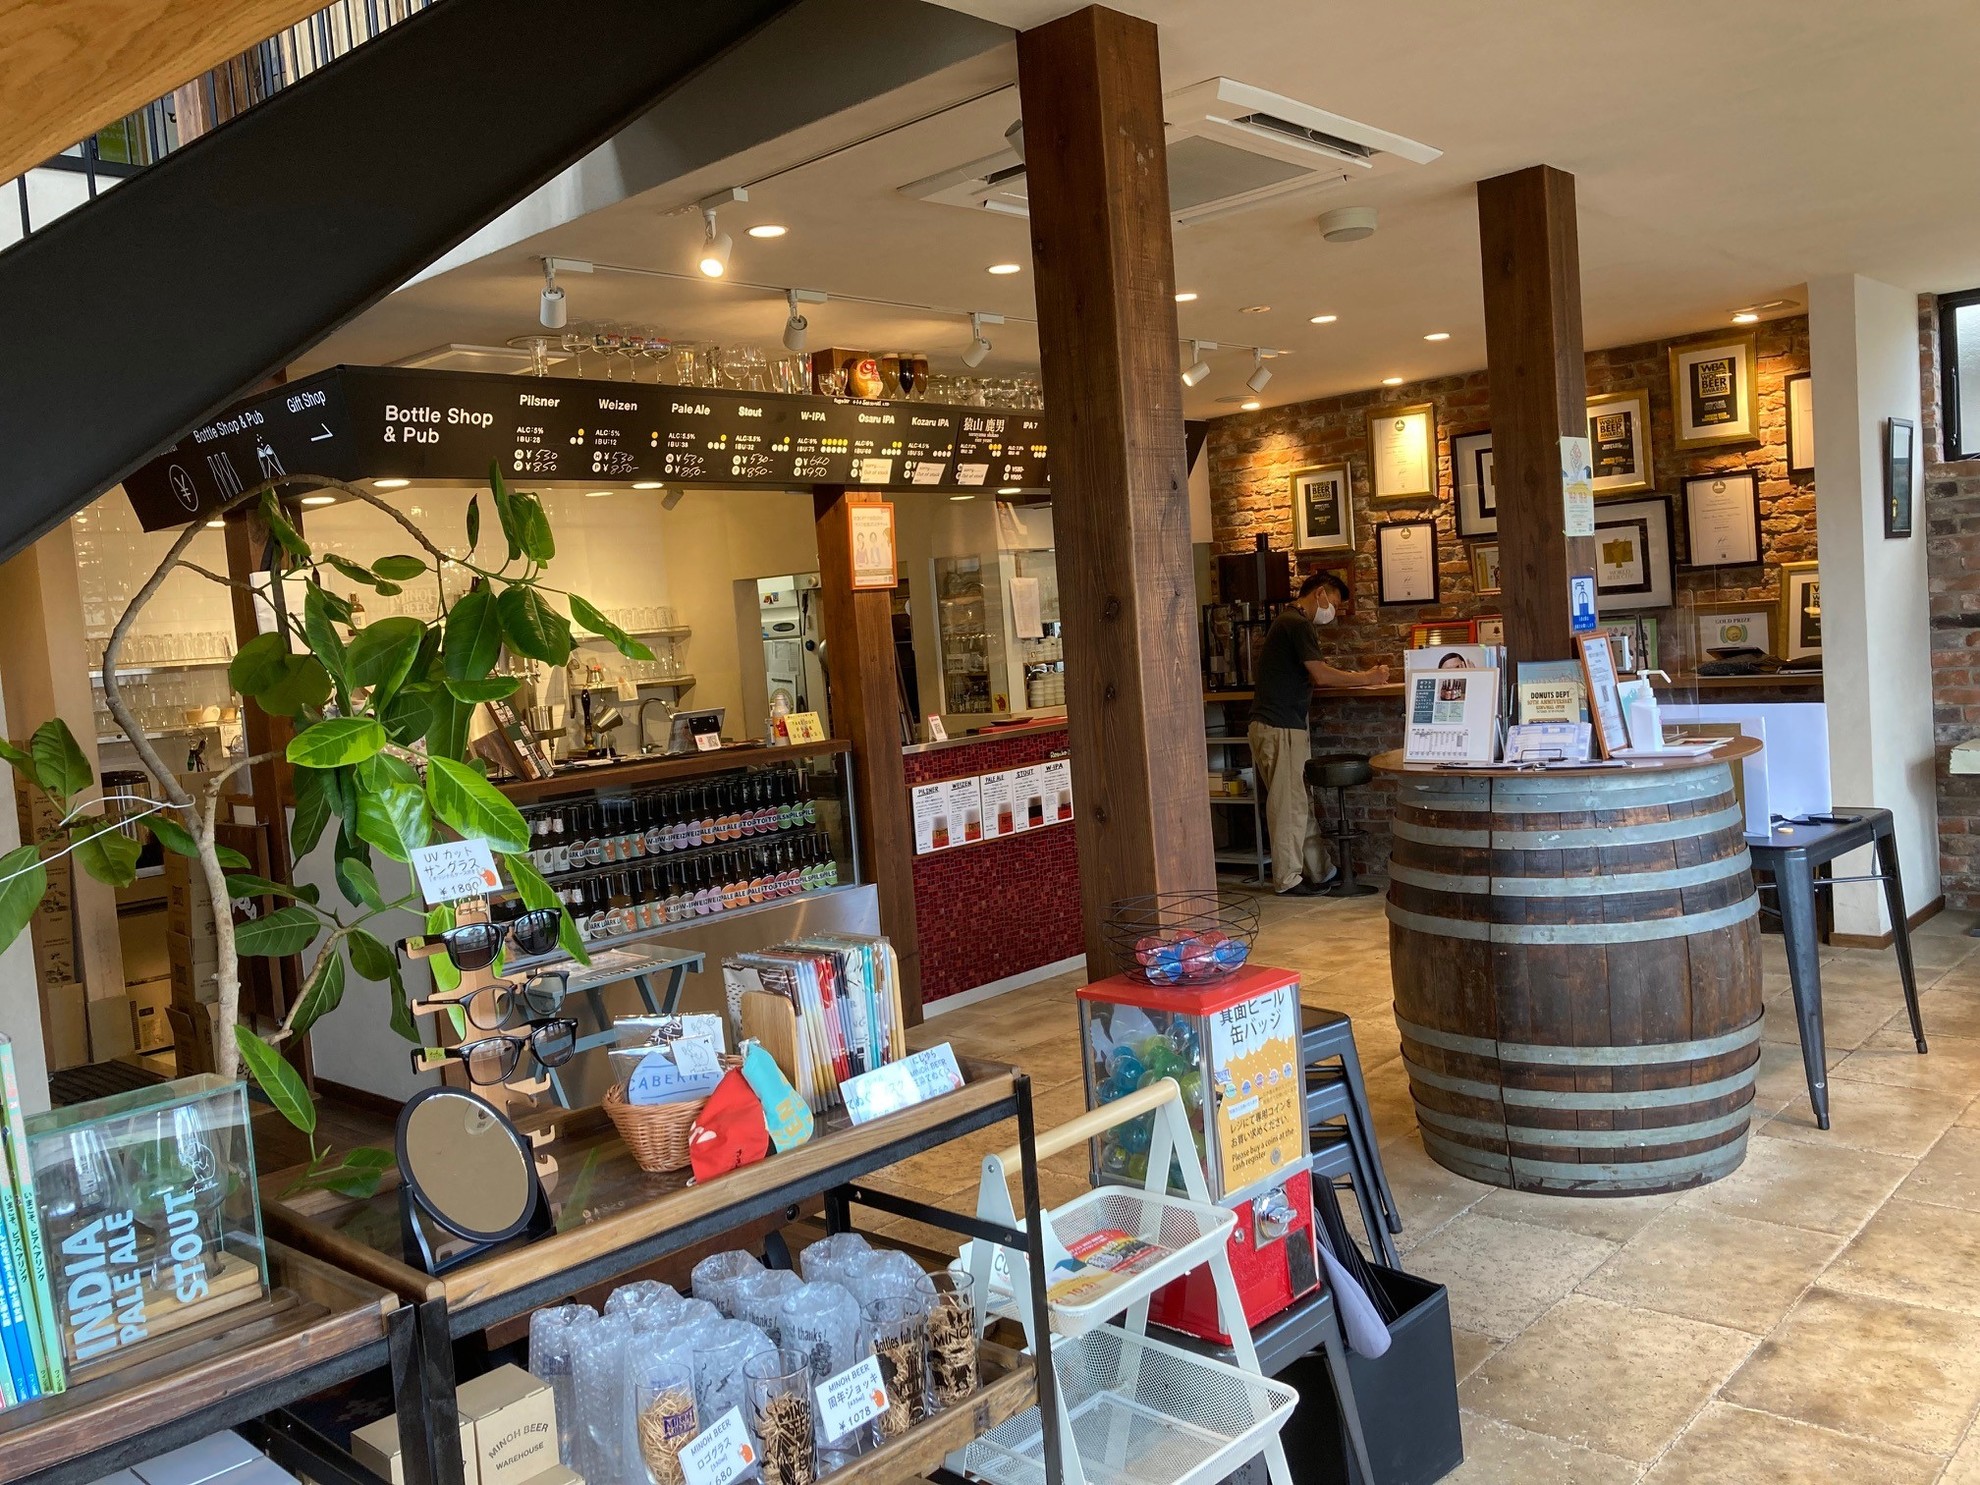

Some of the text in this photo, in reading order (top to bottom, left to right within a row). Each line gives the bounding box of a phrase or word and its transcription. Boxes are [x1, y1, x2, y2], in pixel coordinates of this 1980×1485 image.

[1700, 361, 1726, 373] WBA
[1701, 378, 1727, 388] BEER
[286, 390, 326, 414] Gift Shop
[519, 394, 561, 408] Pilsner
[598, 398, 638, 411] Weizen
[671, 403, 711, 416] Pale Ale
[385, 404, 494, 429] Bottle Shop
[738, 406, 763, 417] Stout
[858, 413, 895, 424] Osaru IPA
[193, 410, 265, 444] Bottle Shop & Pub
[516, 426, 544, 434] ALC:5%
[911, 416, 950, 427] Kozaru IPA
[1600, 424, 1622, 434] BEER
[383, 426, 440, 444] & Pub
[594, 438, 618, 446] IBU:12
[595, 429, 621, 437] ALC:5%
[1312, 486, 1331, 494] BEER
[1530, 690, 1570, 699] DONUTS DEPT
[424, 846, 472, 863] UV カット
[424, 858, 480, 877] サングラス
[1230, 1009, 1281, 1045] 缶バッジ
[1230, 1099, 1292, 1134] レジにて専用コインを
[1231, 1115, 1290, 1148] お買い求めください
[1231, 1148, 1250, 1163] Please
[1250, 1145, 1261, 1155] buy
[1265, 1135, 1279, 1148] coins
[1279, 1132, 1285, 1140] at
[1285, 1128, 1294, 1137] the
[1232, 1151, 1266, 1172] cash register
[164, 1191, 209, 1304] STOUT
[104, 1209, 149, 1346] PALE ALE
[62, 1218, 117, 1361] INDIA
[874, 1336, 900, 1354] Bottles
[828, 1363, 870, 1394] MINOH BEER
[828, 1373, 878, 1410] 周年ジョッキ
[488, 1422, 549, 1459] MINOH BEER
[690, 1418, 732, 1457] MINOH BEER
[496, 1442, 544, 1471] WAREHOUSE
[697, 1437, 732, 1470] ロゴグラス
